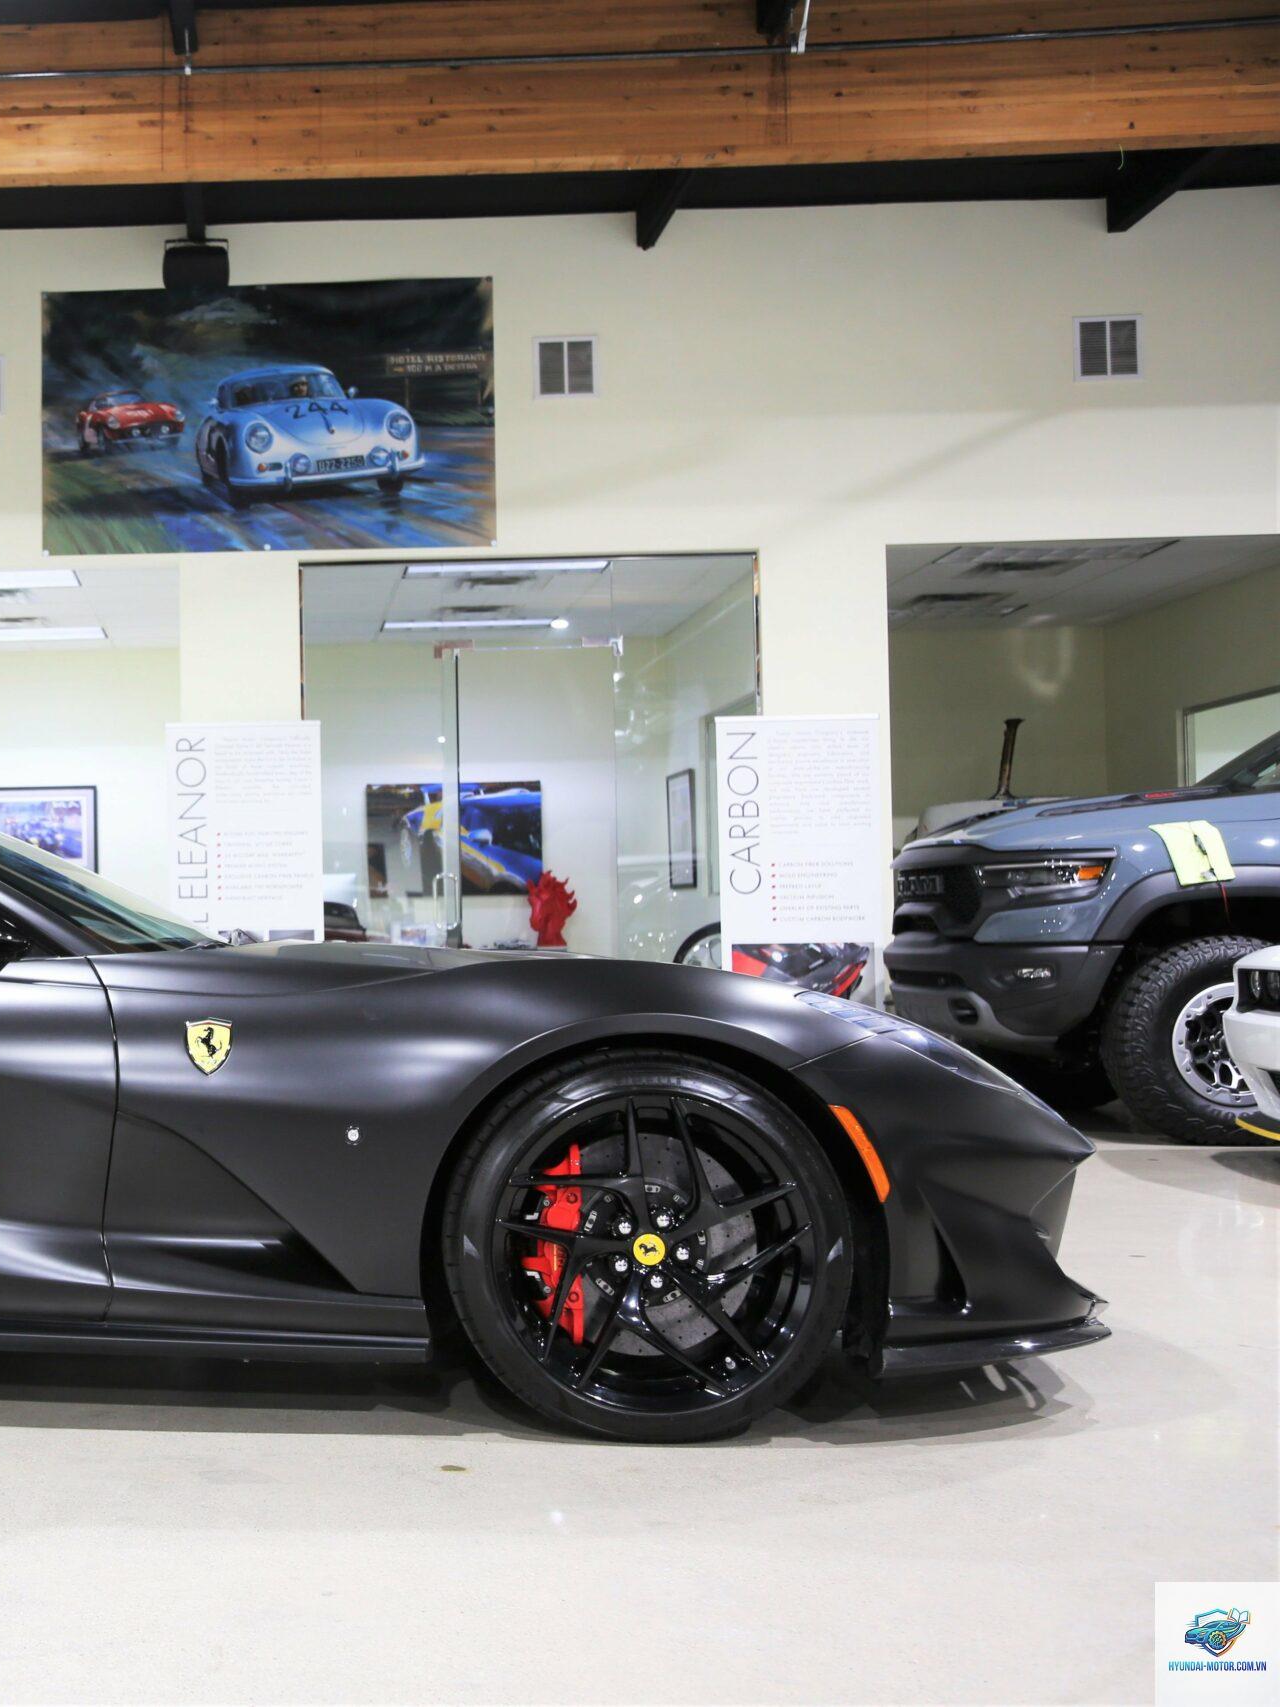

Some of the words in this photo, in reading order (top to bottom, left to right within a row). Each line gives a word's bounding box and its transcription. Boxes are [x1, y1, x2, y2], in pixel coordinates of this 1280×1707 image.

[285, 402, 348, 420] 244
[176, 737, 208, 898] ELEANOR
[726, 732, 762, 895] CARBON
